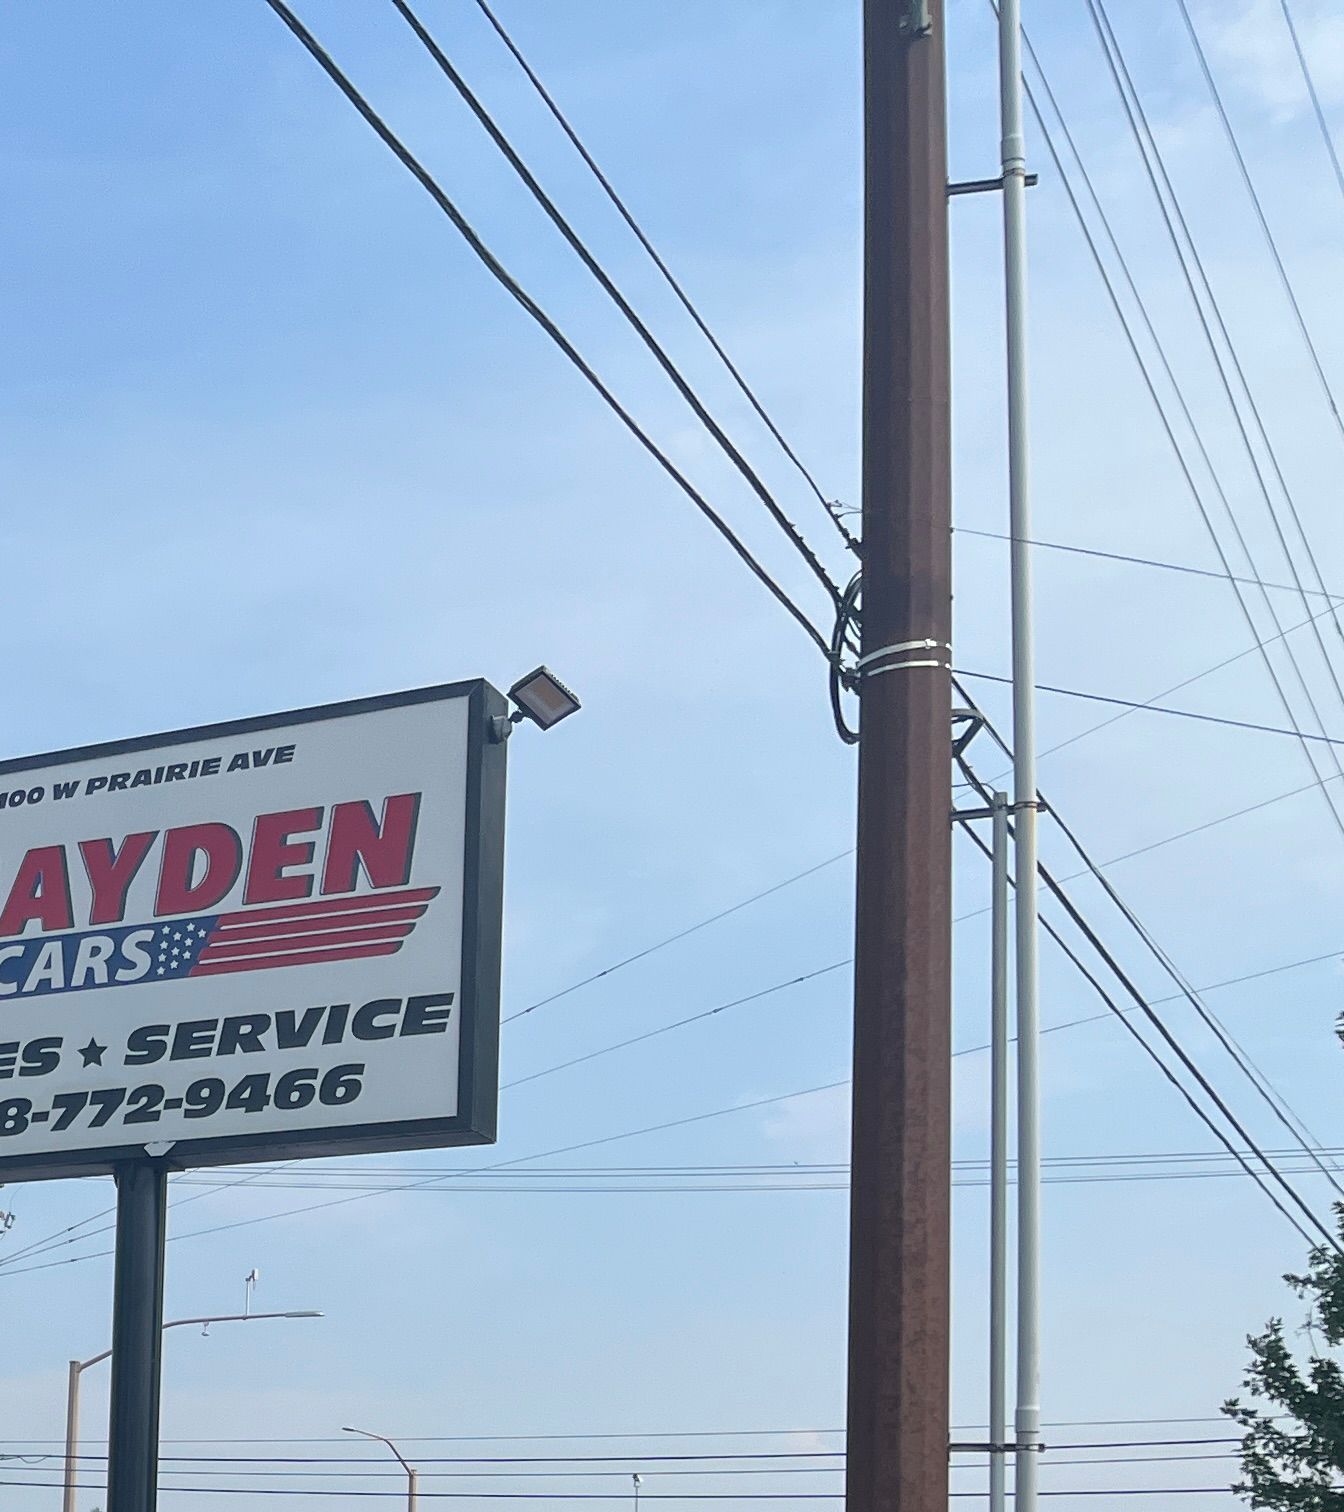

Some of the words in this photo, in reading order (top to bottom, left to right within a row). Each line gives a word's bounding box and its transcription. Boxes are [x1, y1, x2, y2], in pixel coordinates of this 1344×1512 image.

[53, 780, 81, 800] W
[84, 757, 223, 796] PRAIRIE
[226, 744, 297, 772] AVE
[123, 992, 455, 1067] SERVICE
